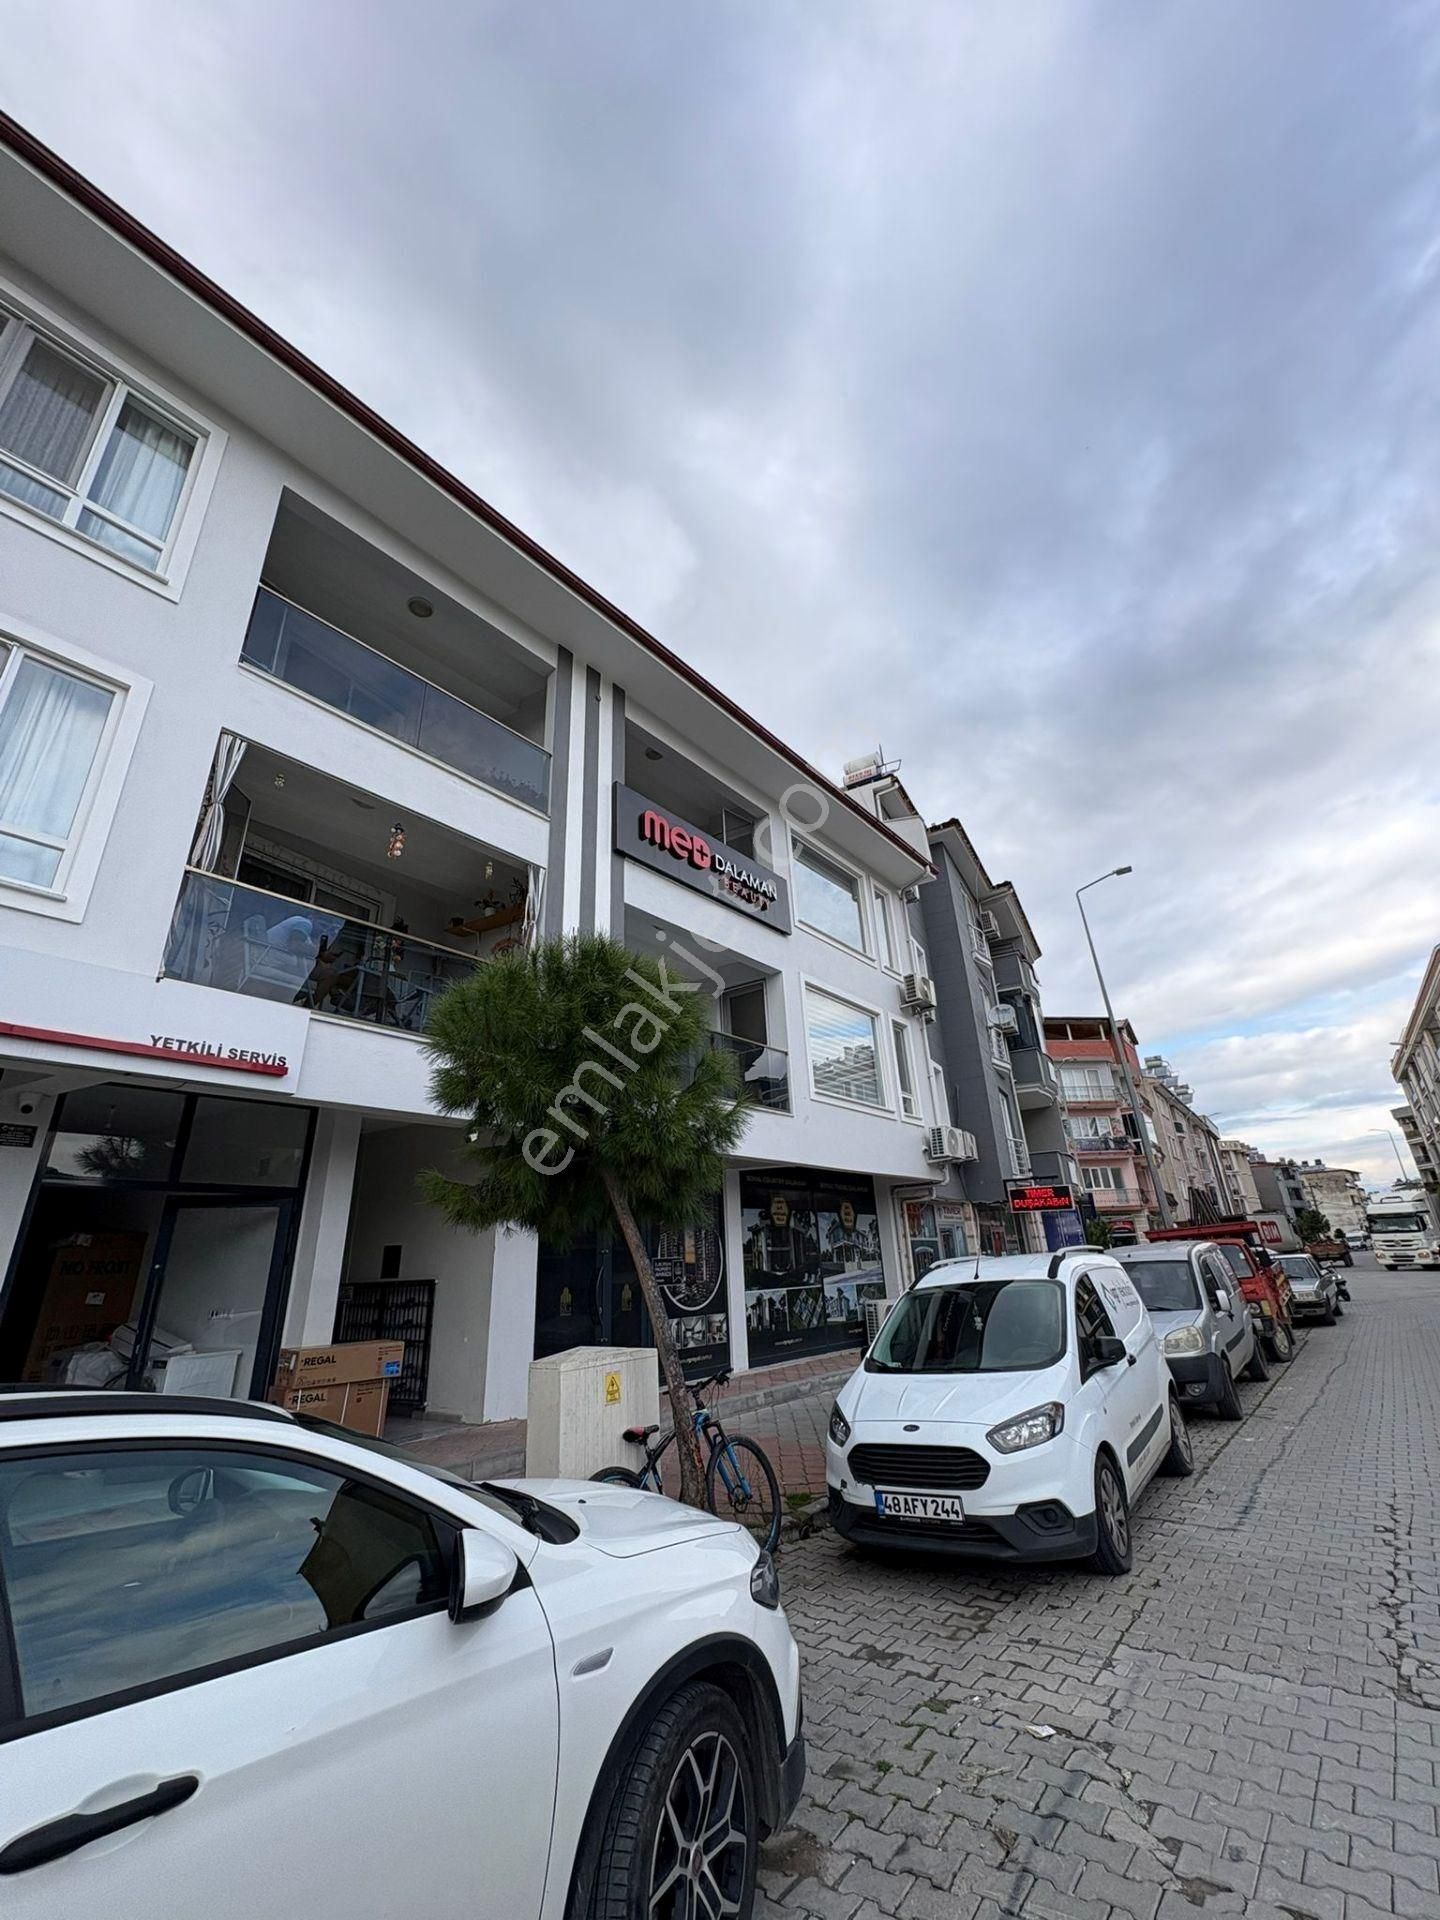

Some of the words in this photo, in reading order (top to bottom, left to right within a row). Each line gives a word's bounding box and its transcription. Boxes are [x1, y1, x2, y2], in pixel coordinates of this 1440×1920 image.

[715, 853, 778, 901] DALAMAN
[150, 1034, 223, 1058] YETKİLİ
[227, 1046, 288, 1068] SERVİS
[303, 1354, 337, 1367] REGAL
[291, 1392, 327, 1405] REGAL
[884, 1495, 902, 1513] 48
[904, 1497, 928, 1516] AFY
[931, 1500, 960, 1519] 244
